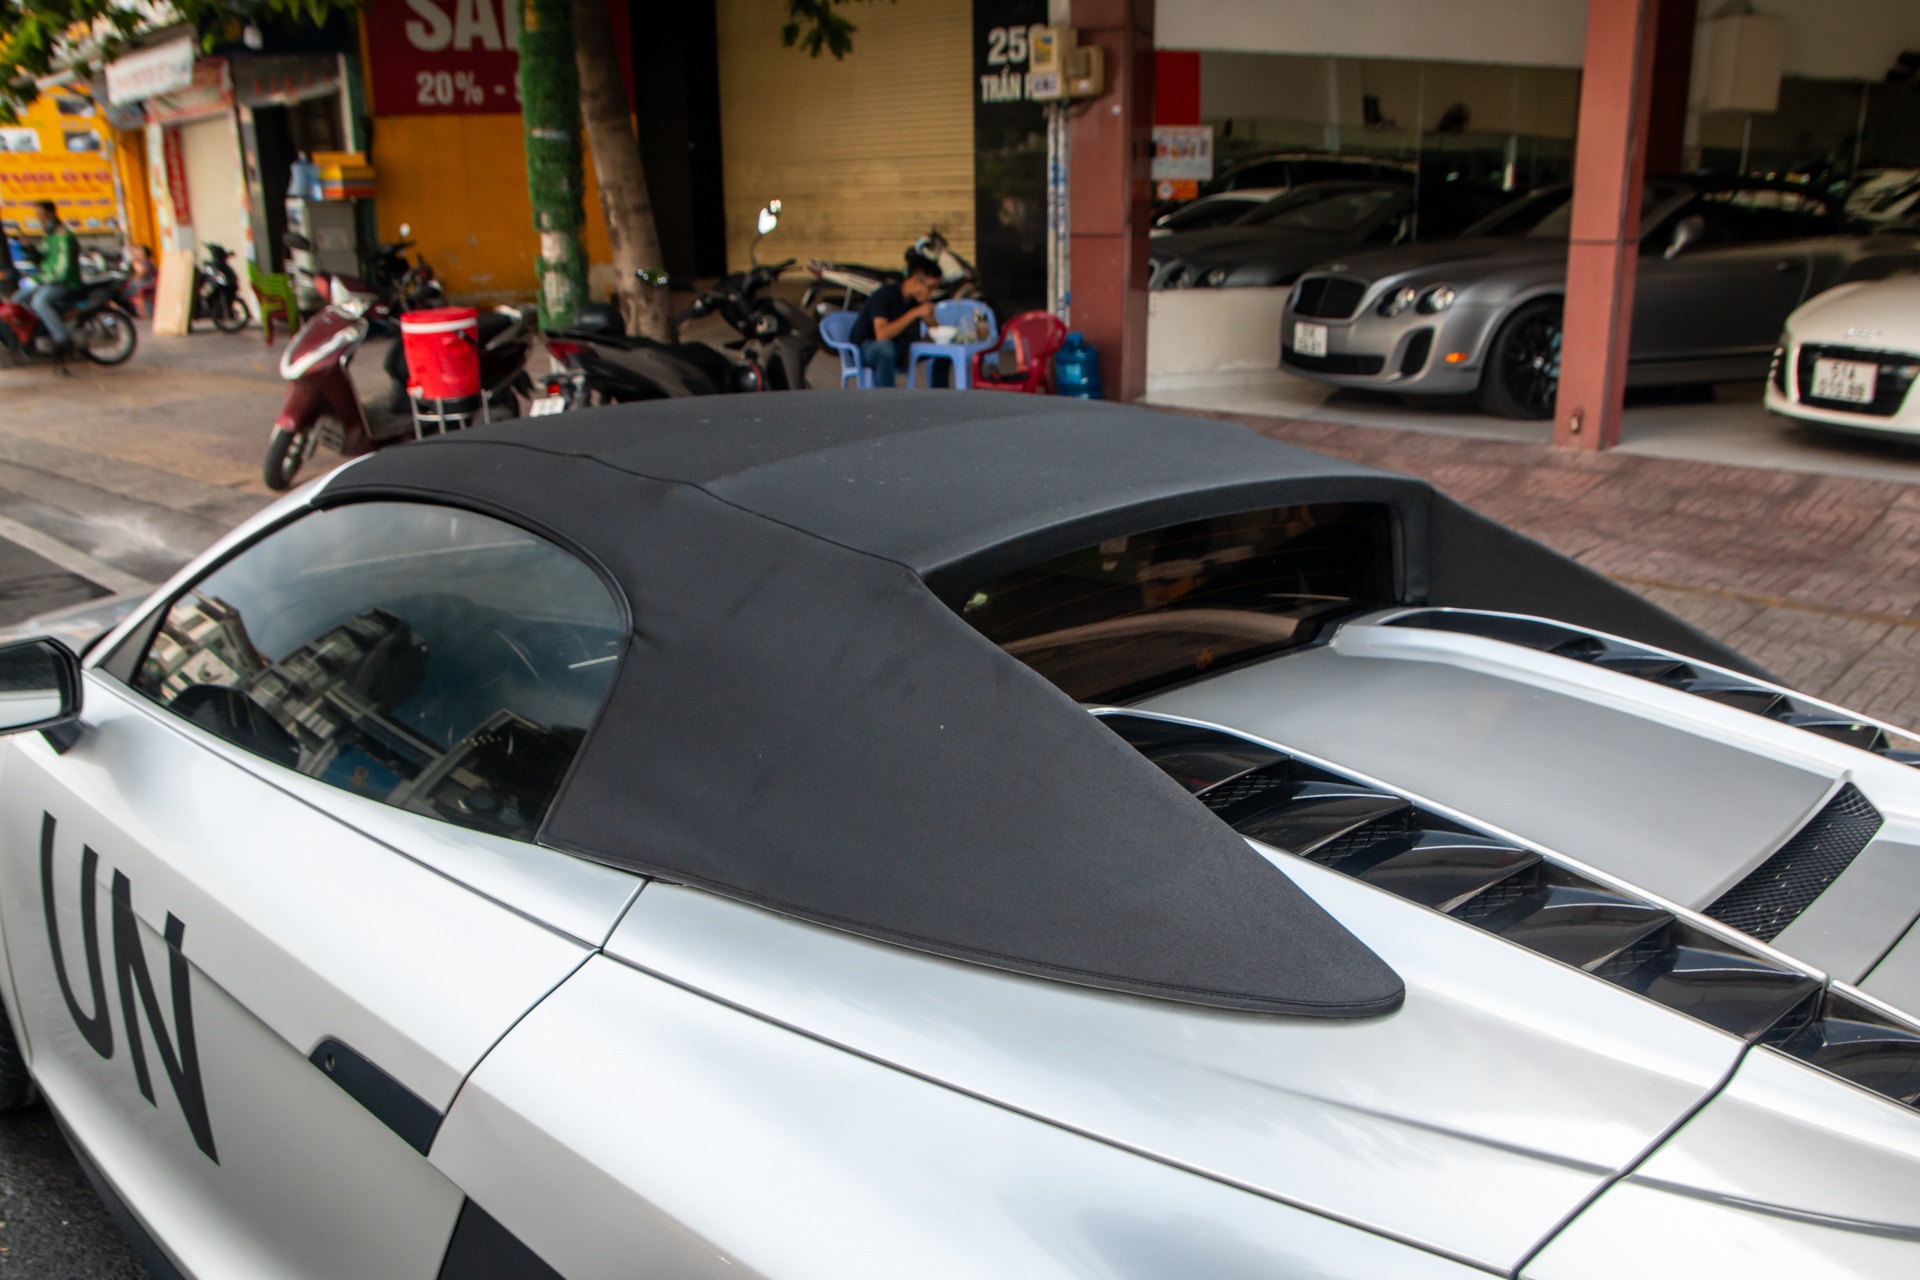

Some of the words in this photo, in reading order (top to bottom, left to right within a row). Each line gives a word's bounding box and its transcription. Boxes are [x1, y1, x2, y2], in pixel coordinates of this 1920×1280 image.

[988, 24, 1045, 66] 25
[417, 70, 484, 105] 20%
[39, 809, 221, 1168] UN
